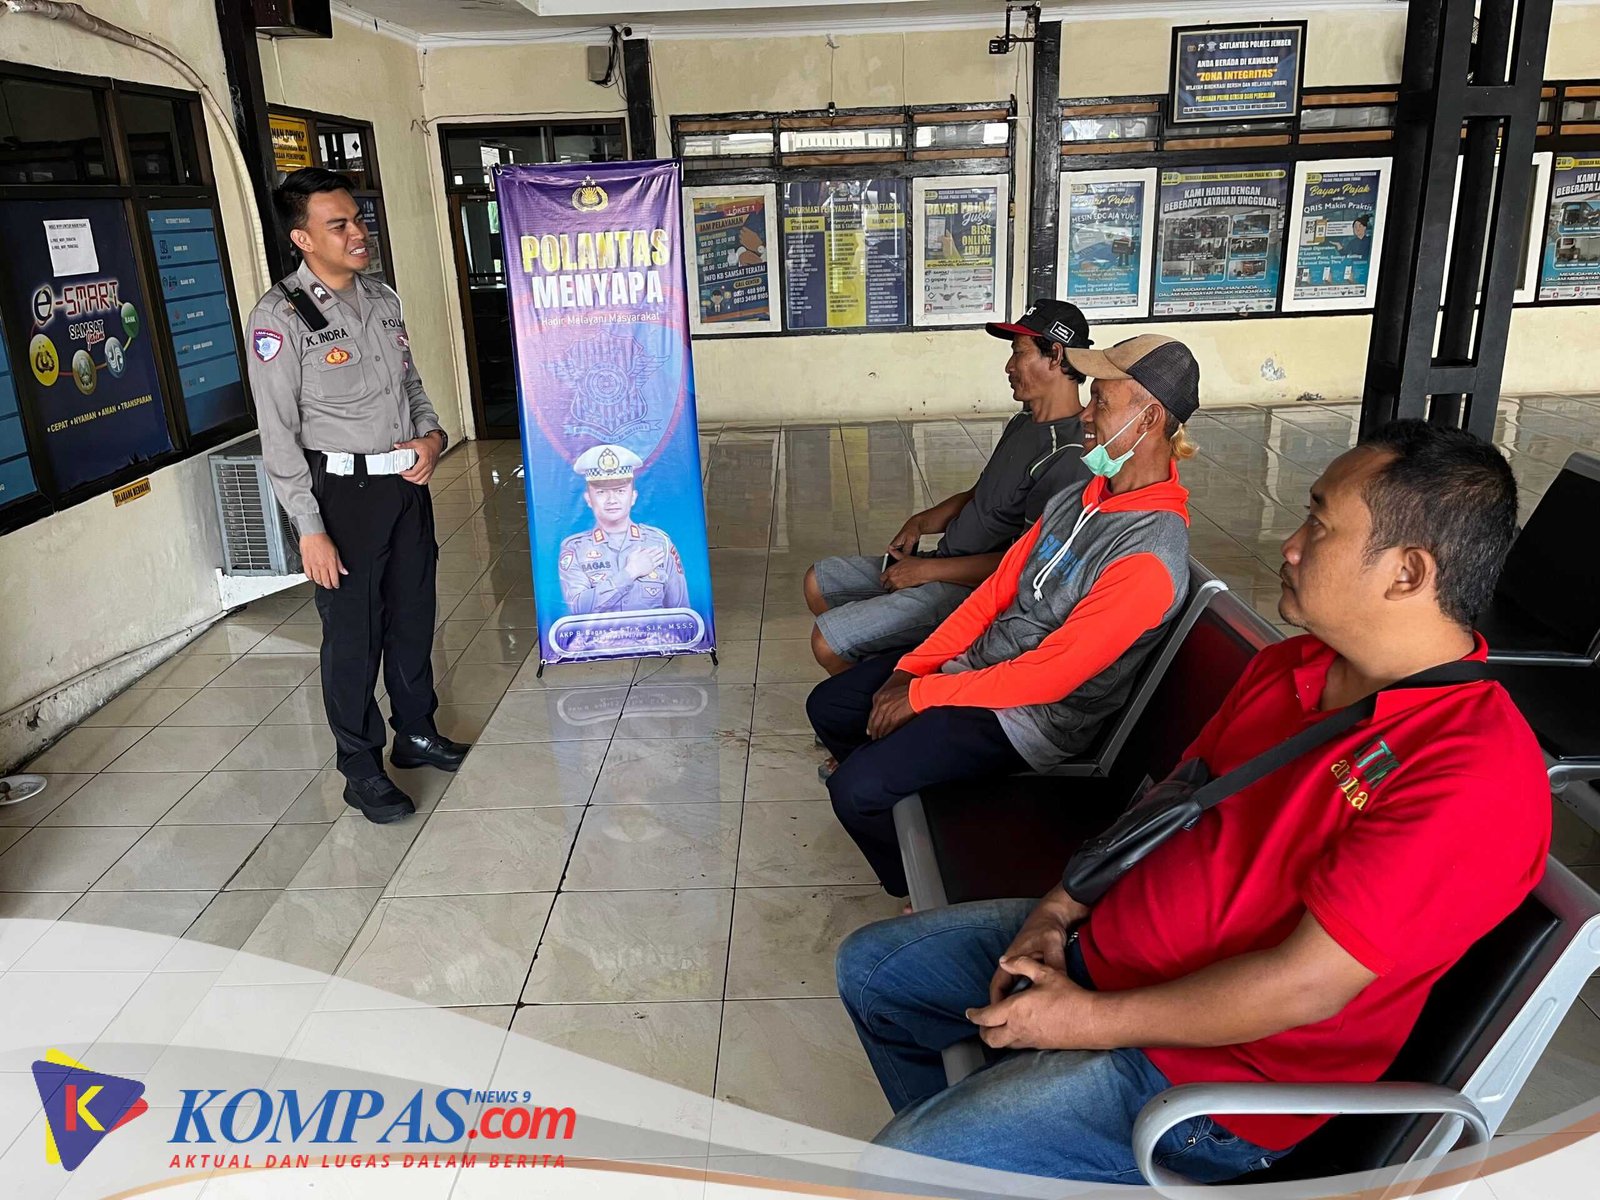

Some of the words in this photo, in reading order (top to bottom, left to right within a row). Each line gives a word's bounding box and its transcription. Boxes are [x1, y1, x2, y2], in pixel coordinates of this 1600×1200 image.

[1219, 41, 1249, 50] SATLANTAS
[1250, 40, 1270, 48] POLRES
[1197, 60, 1214, 68] ANDA
[1215, 58, 1238, 67] BERADA
[1240, 58, 1247, 66] DI
[1247, 56, 1279, 65] KAWASAN
[1576, 173, 1596, 183] KAMI
[1184, 187, 1204, 199] KAMI
[1205, 186, 1230, 196] HADIR
[1230, 186, 1261, 196] DENGAN
[1309, 185, 1340, 198] Bayar
[1342, 183, 1371, 196] Pajak
[1556, 183, 1593, 197] BEBERAPA
[1107, 194, 1136, 207] Pajak
[1164, 199, 1202, 212] BEBERAPA
[1203, 196, 1237, 206] LAYANAN
[728, 205, 750, 216] LOKET
[788, 206, 820, 214] INFORMASI
[926, 202, 959, 215] BAYAR
[1303, 203, 1323, 214] QRIS
[1324, 202, 1346, 210] Makin
[1347, 202, 1372, 211] Praktis
[699, 222, 711, 232] JAM
[711, 216, 744, 230] PELAYANAN
[971, 224, 992, 235] BISA
[961, 235, 991, 245] ONLINE
[520, 229, 671, 273] POLANTAS
[964, 245, 980, 255] LOH
[704, 273, 716, 282] INFO
[724, 269, 745, 279] SAMSAT
[745, 265, 766, 275] TERATAI
[531, 270, 664, 309] MENYAPA
[33, 281, 118, 325] e-SMART
[541, 316, 565, 326] Hadir
[567, 314, 607, 326] Melayani
[608, 312, 661, 325] Masyarakat
[69, 319, 105, 341] SAMSAT
[305, 336, 319, 347] K.
[319, 328, 349, 344] INDRA
[50, 419, 69, 432] CEPAT
[73, 410, 97, 425] NYAMAN
[101, 404, 117, 417] AMAN
[120, 394, 153, 411] TRANSPARAN
[559, 631, 574, 639] AKP
[585, 629, 607, 637] Bagas
